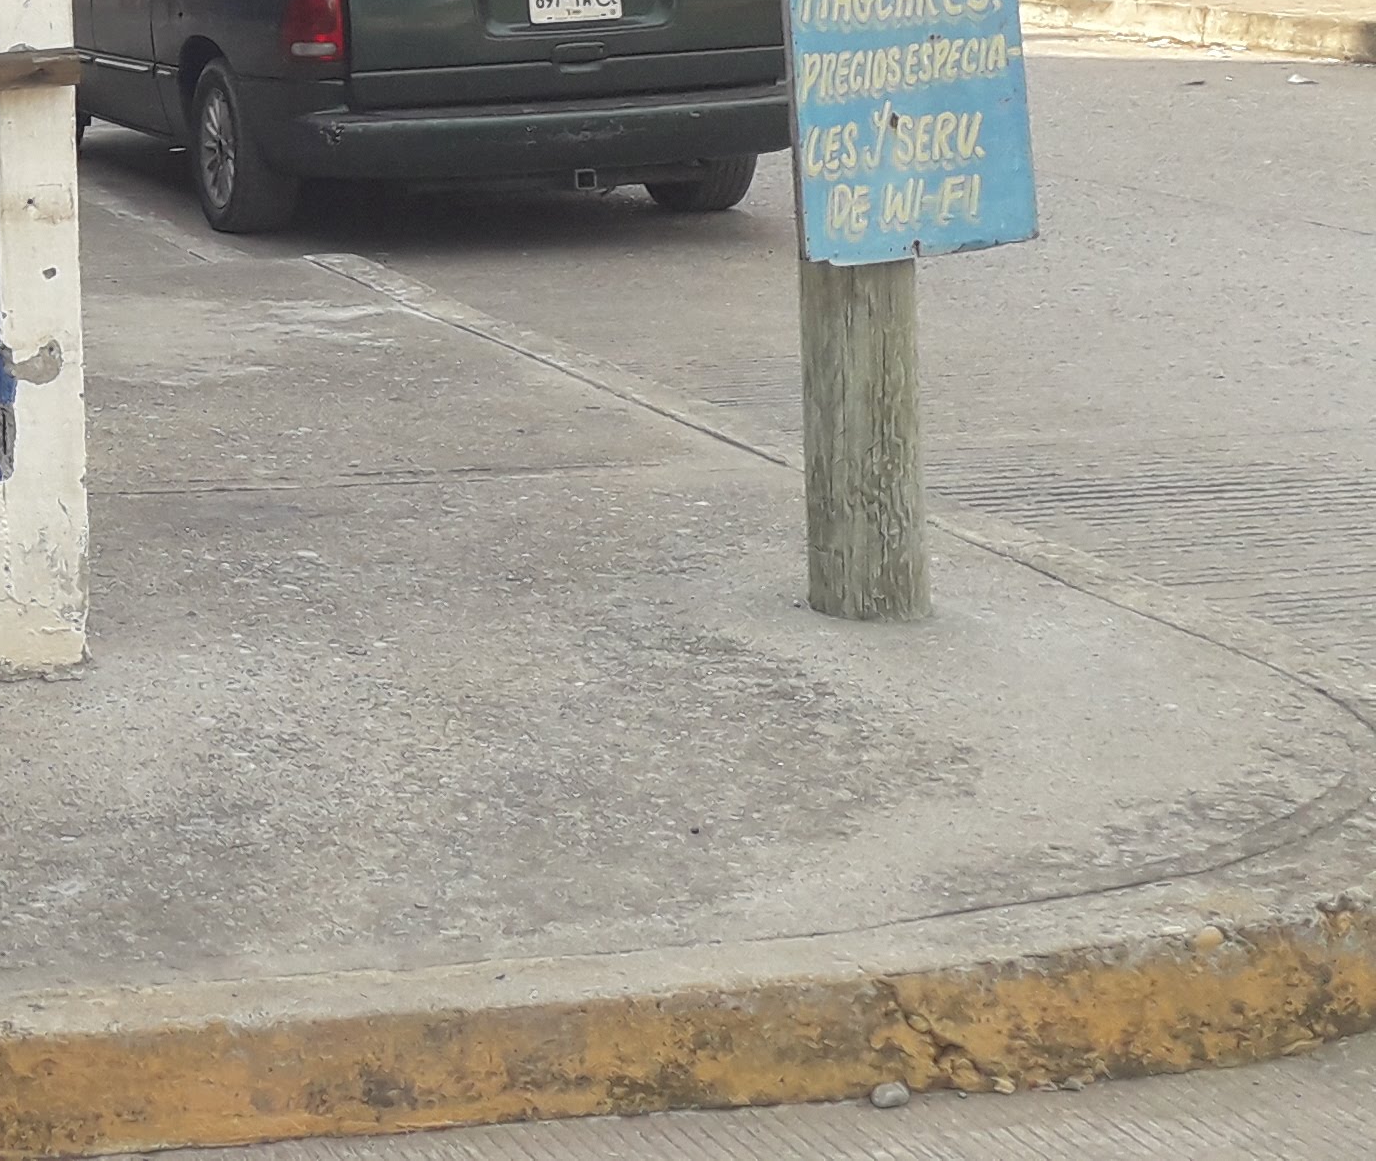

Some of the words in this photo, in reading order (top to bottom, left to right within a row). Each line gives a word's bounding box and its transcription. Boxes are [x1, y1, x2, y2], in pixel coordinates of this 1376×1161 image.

[806, 122, 857, 178] LES
[831, 183, 870, 231] DE
[883, 173, 981, 226] WI-FI
